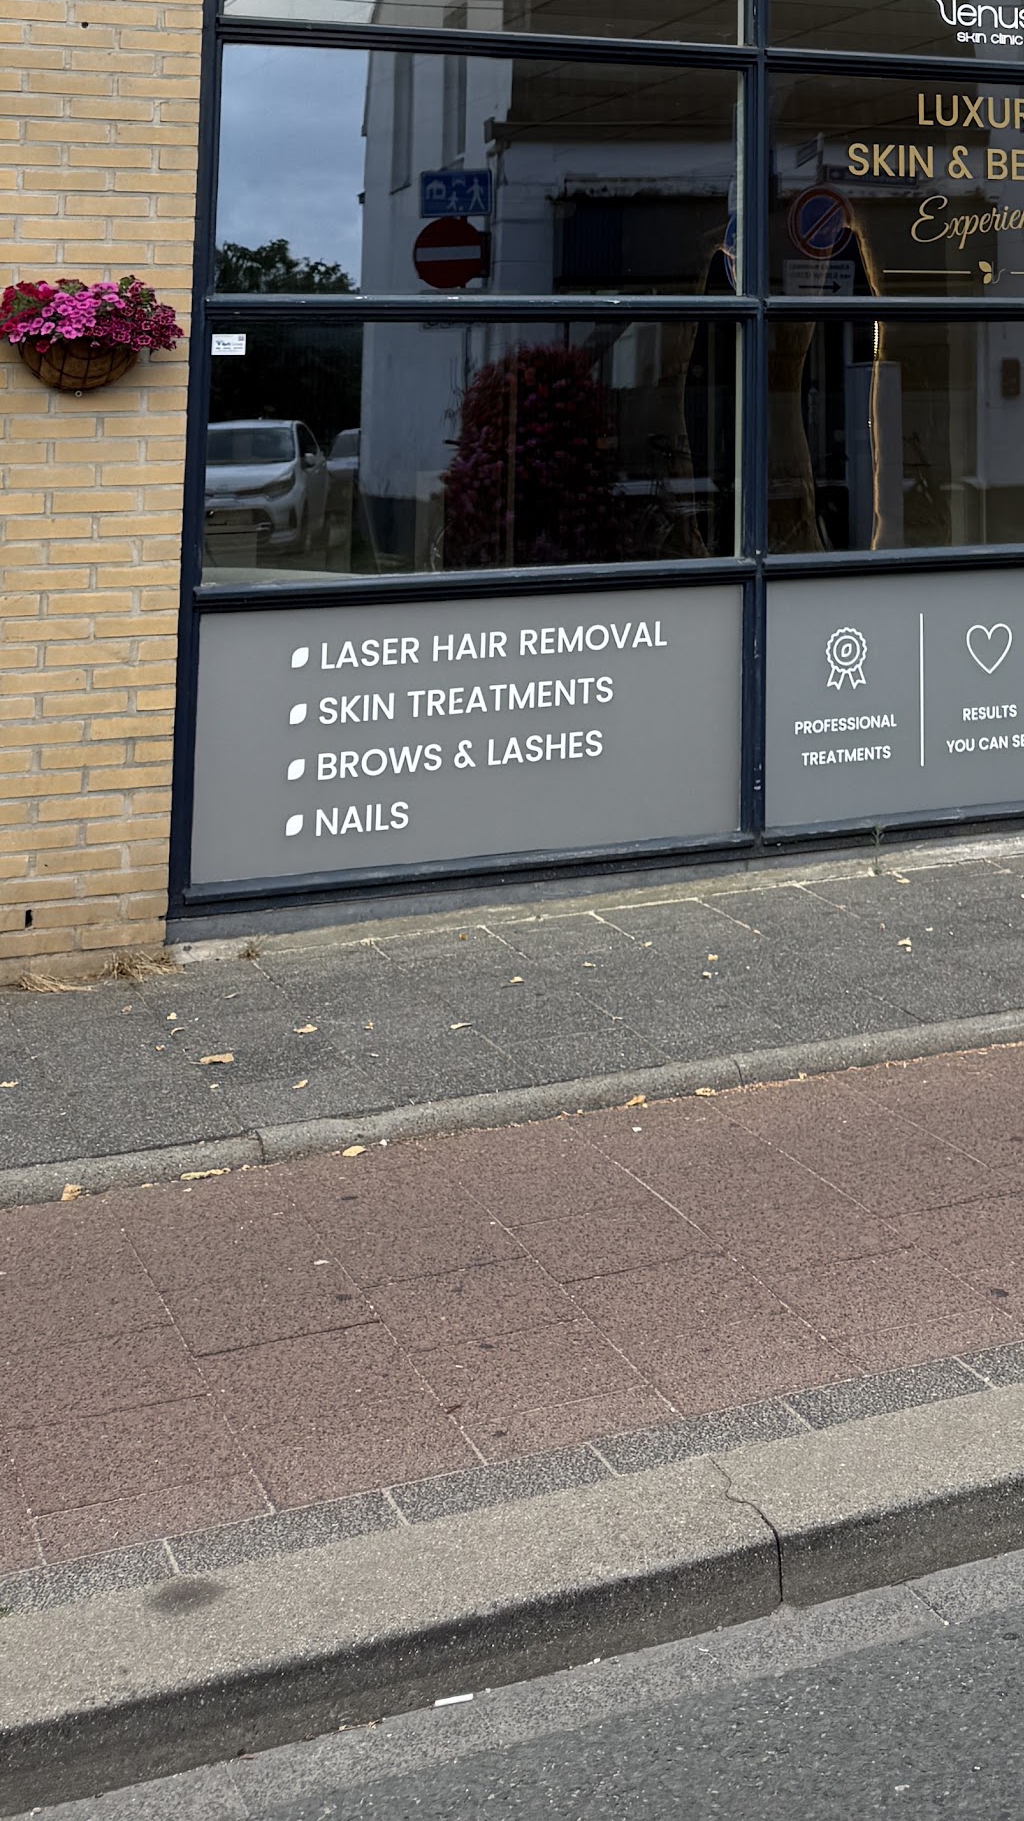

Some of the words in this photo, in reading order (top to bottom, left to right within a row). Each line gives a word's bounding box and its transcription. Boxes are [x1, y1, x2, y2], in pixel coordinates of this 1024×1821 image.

[956, 31, 987, 44] skin
[990, 32, 1024, 46] clinic
[847, 142, 935, 179] SKIN
[948, 144, 974, 180] &
[321, 636, 420, 670] LASER
[432, 631, 508, 662] HAIR
[518, 620, 668, 656] REMOVAL
[318, 692, 395, 725] SKIN
[407, 676, 614, 718] TREATMENTS
[962, 704, 1018, 722] RESULTS
[794, 713, 898, 736] PROFESSIONAL
[316, 743, 443, 781] BROWS
[453, 739, 476, 769] &
[487, 729, 604, 766] LASHES
[801, 744, 892, 767] TREATMENTS
[946, 737, 976, 754] YOU
[978, 734, 1009, 751] CAN
[315, 801, 409, 837] NAILS
